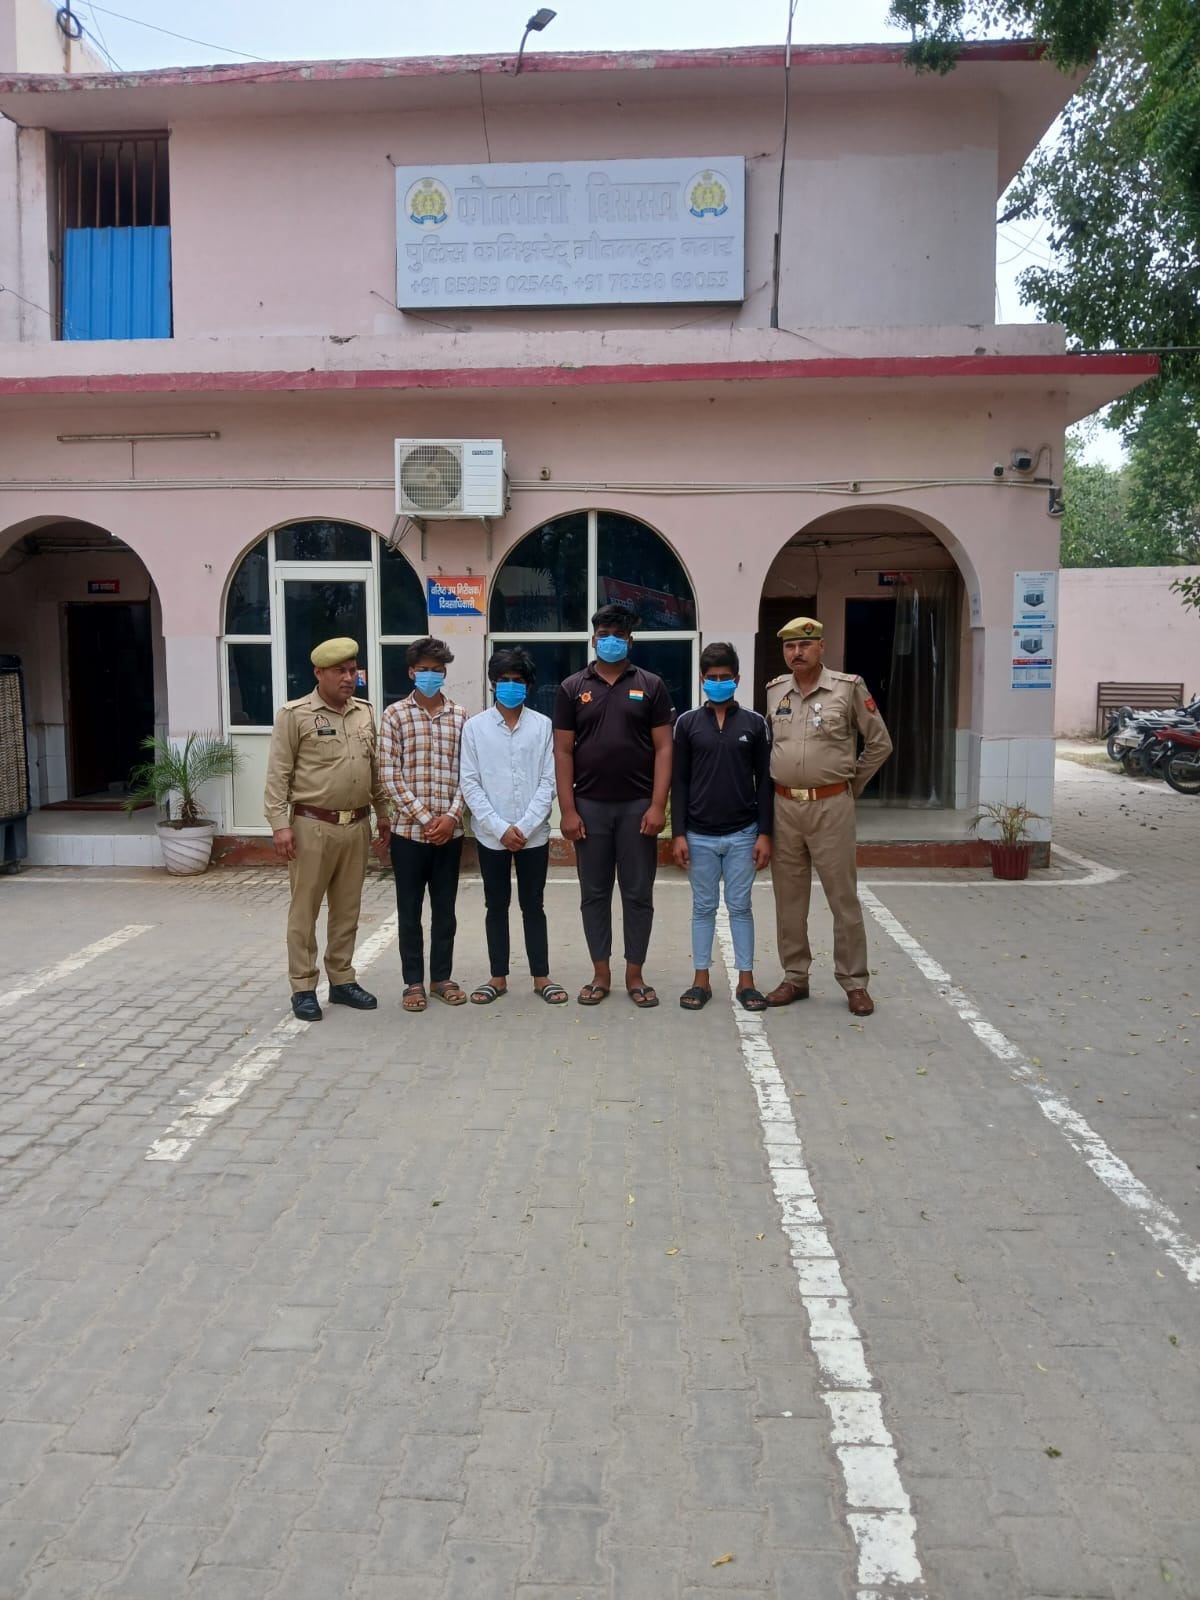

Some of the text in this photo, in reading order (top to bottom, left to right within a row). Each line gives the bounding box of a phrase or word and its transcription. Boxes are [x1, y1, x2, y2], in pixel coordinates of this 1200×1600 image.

[454, 172, 571, 225] कोतवाली
[404, 234, 469, 272] पुलिस
[680, 235, 735, 258] नगर
[411, 276, 440, 296] +91
[575, 273, 603, 293] +91
